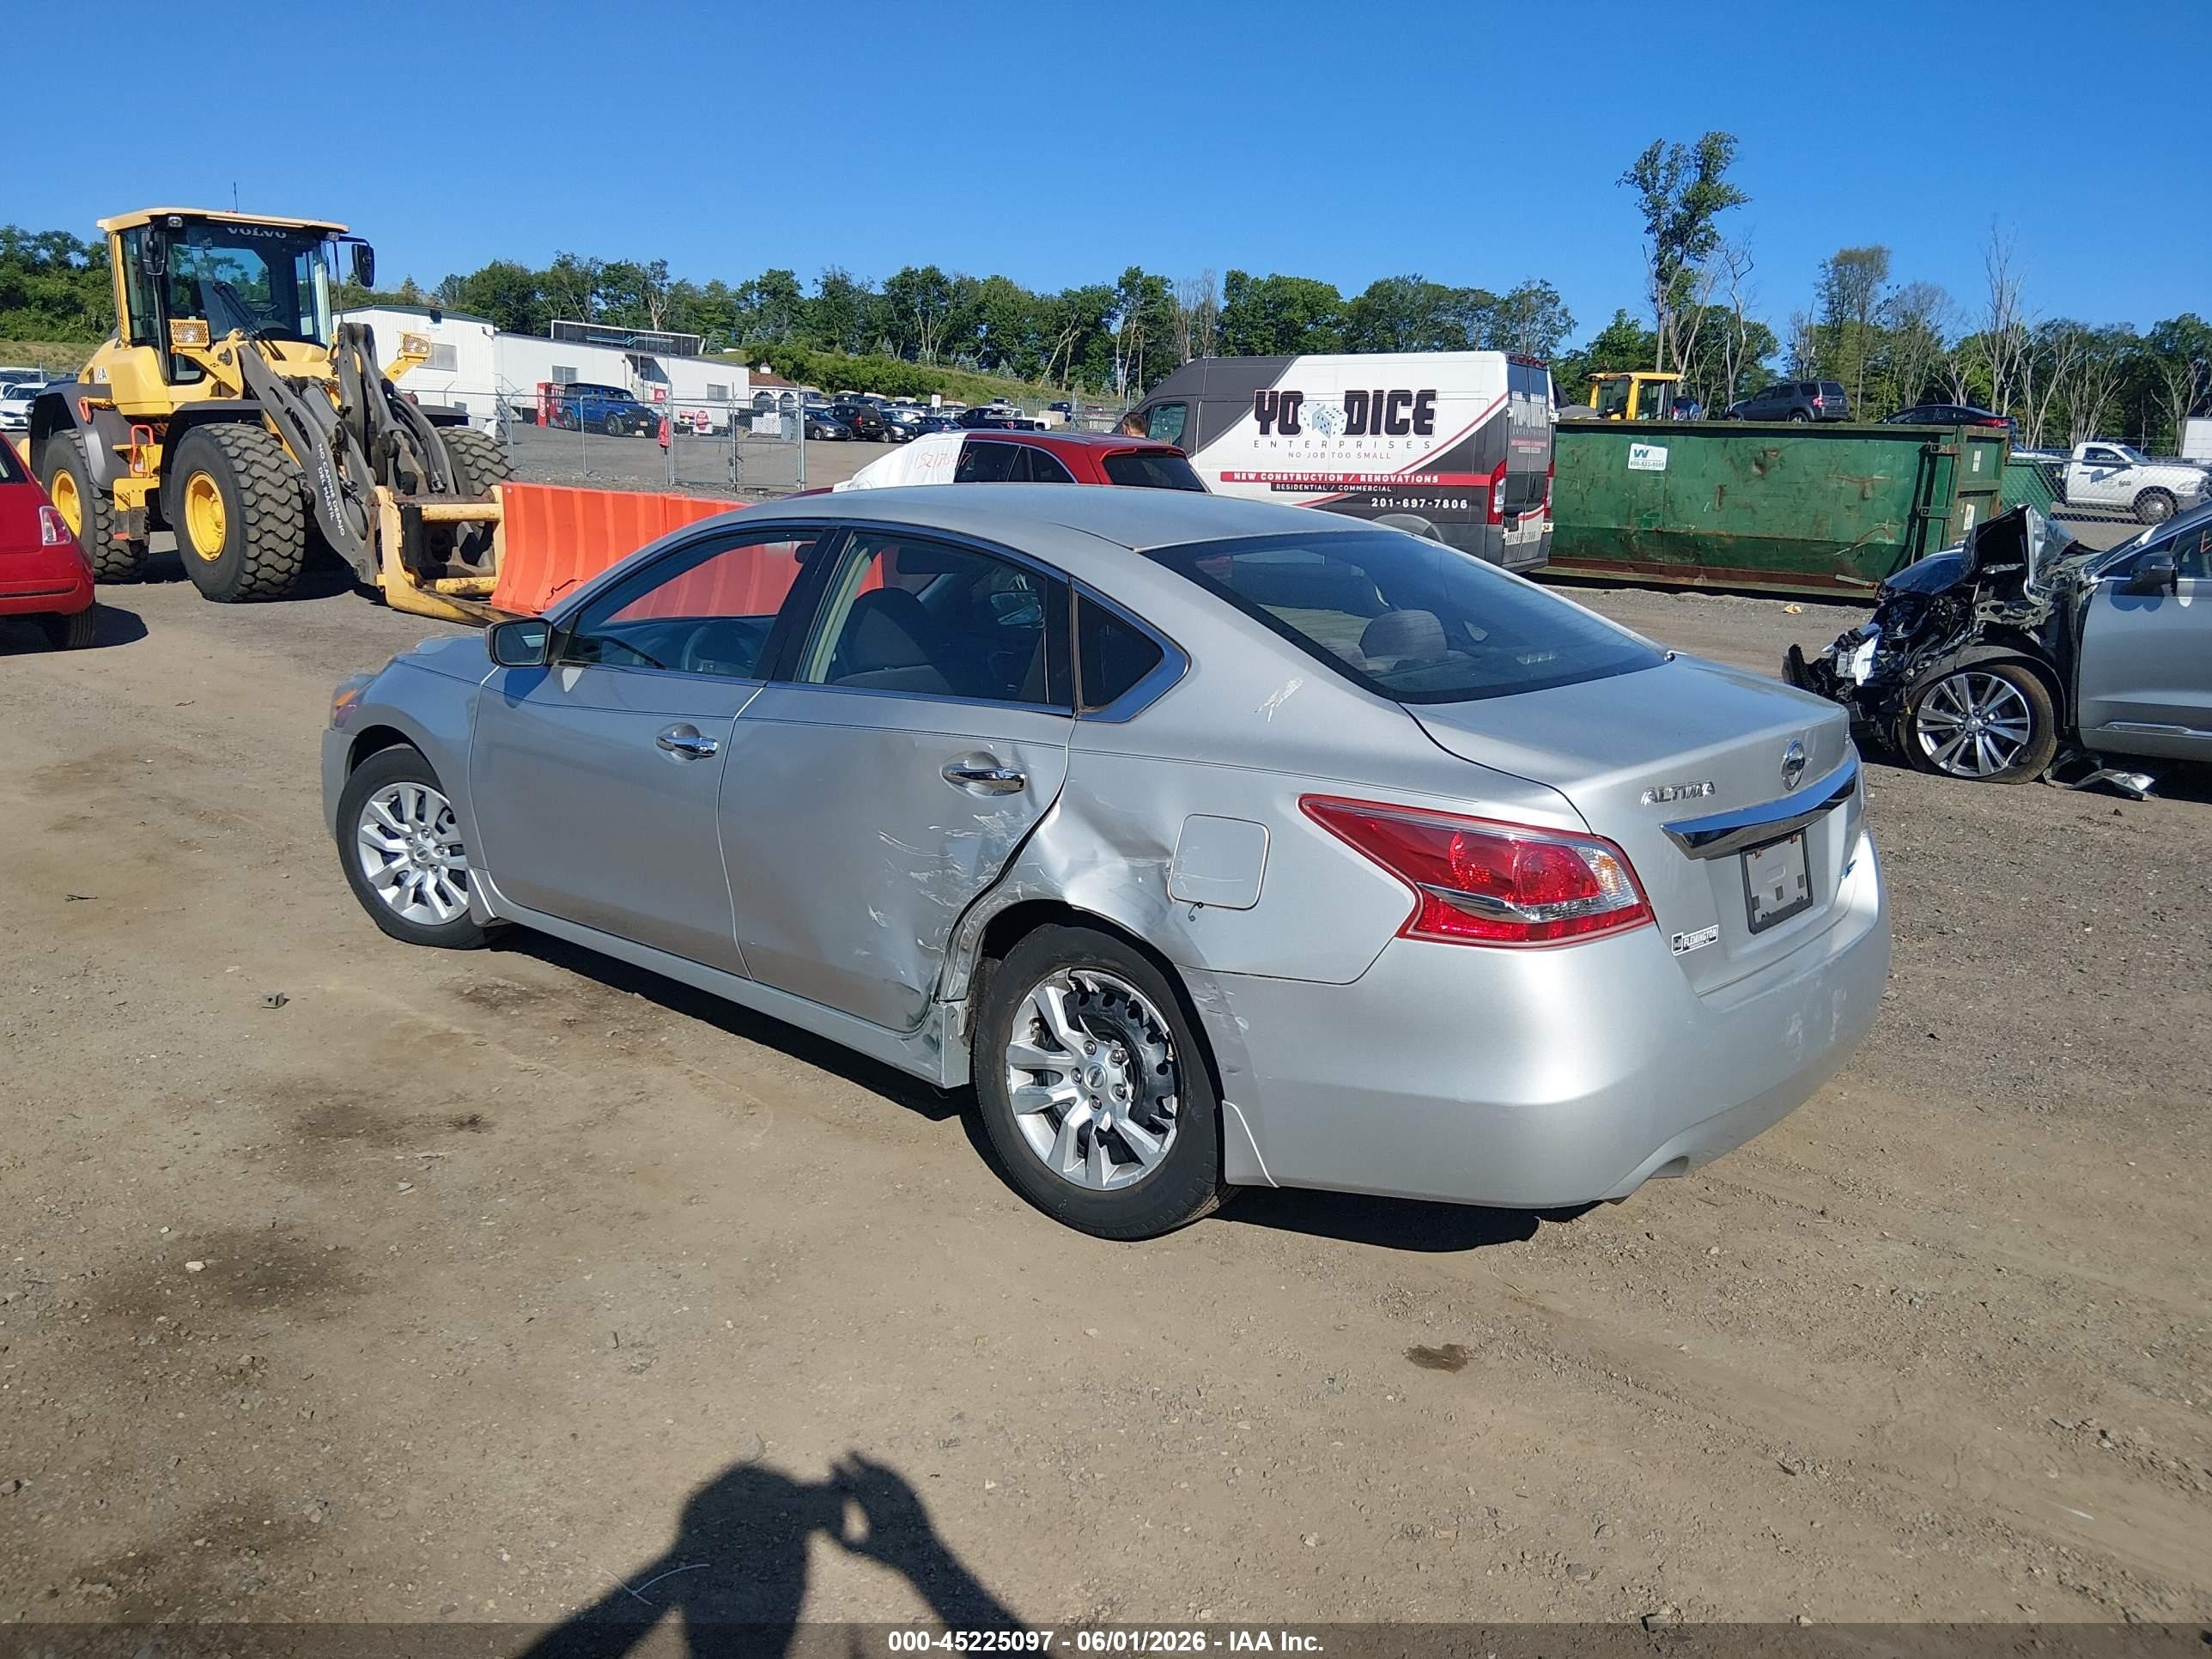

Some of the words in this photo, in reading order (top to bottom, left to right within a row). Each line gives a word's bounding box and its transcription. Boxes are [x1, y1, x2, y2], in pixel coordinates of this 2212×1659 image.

[226, 226, 287, 239] VOLVO
[1254, 390, 1304, 437] YO
[1341, 389, 1437, 437] DICE
[1254, 440, 1431, 449] ENTERPRISES
[1233, 472, 1257, 481] NEW
[1261, 473, 1344, 482] CONSTRUCTION
[1359, 474, 1439, 483] RENOVATIONS
[318, 443, 325, 459] NO
[323, 461, 337, 499] CAMINE
[332, 500, 345, 537] DEBAJO
[1371, 498, 1468, 509] 201-697-7806
[1641, 781, 1716, 805] ALTIMA
[1683, 927, 1717, 948] FLEMINGTON
